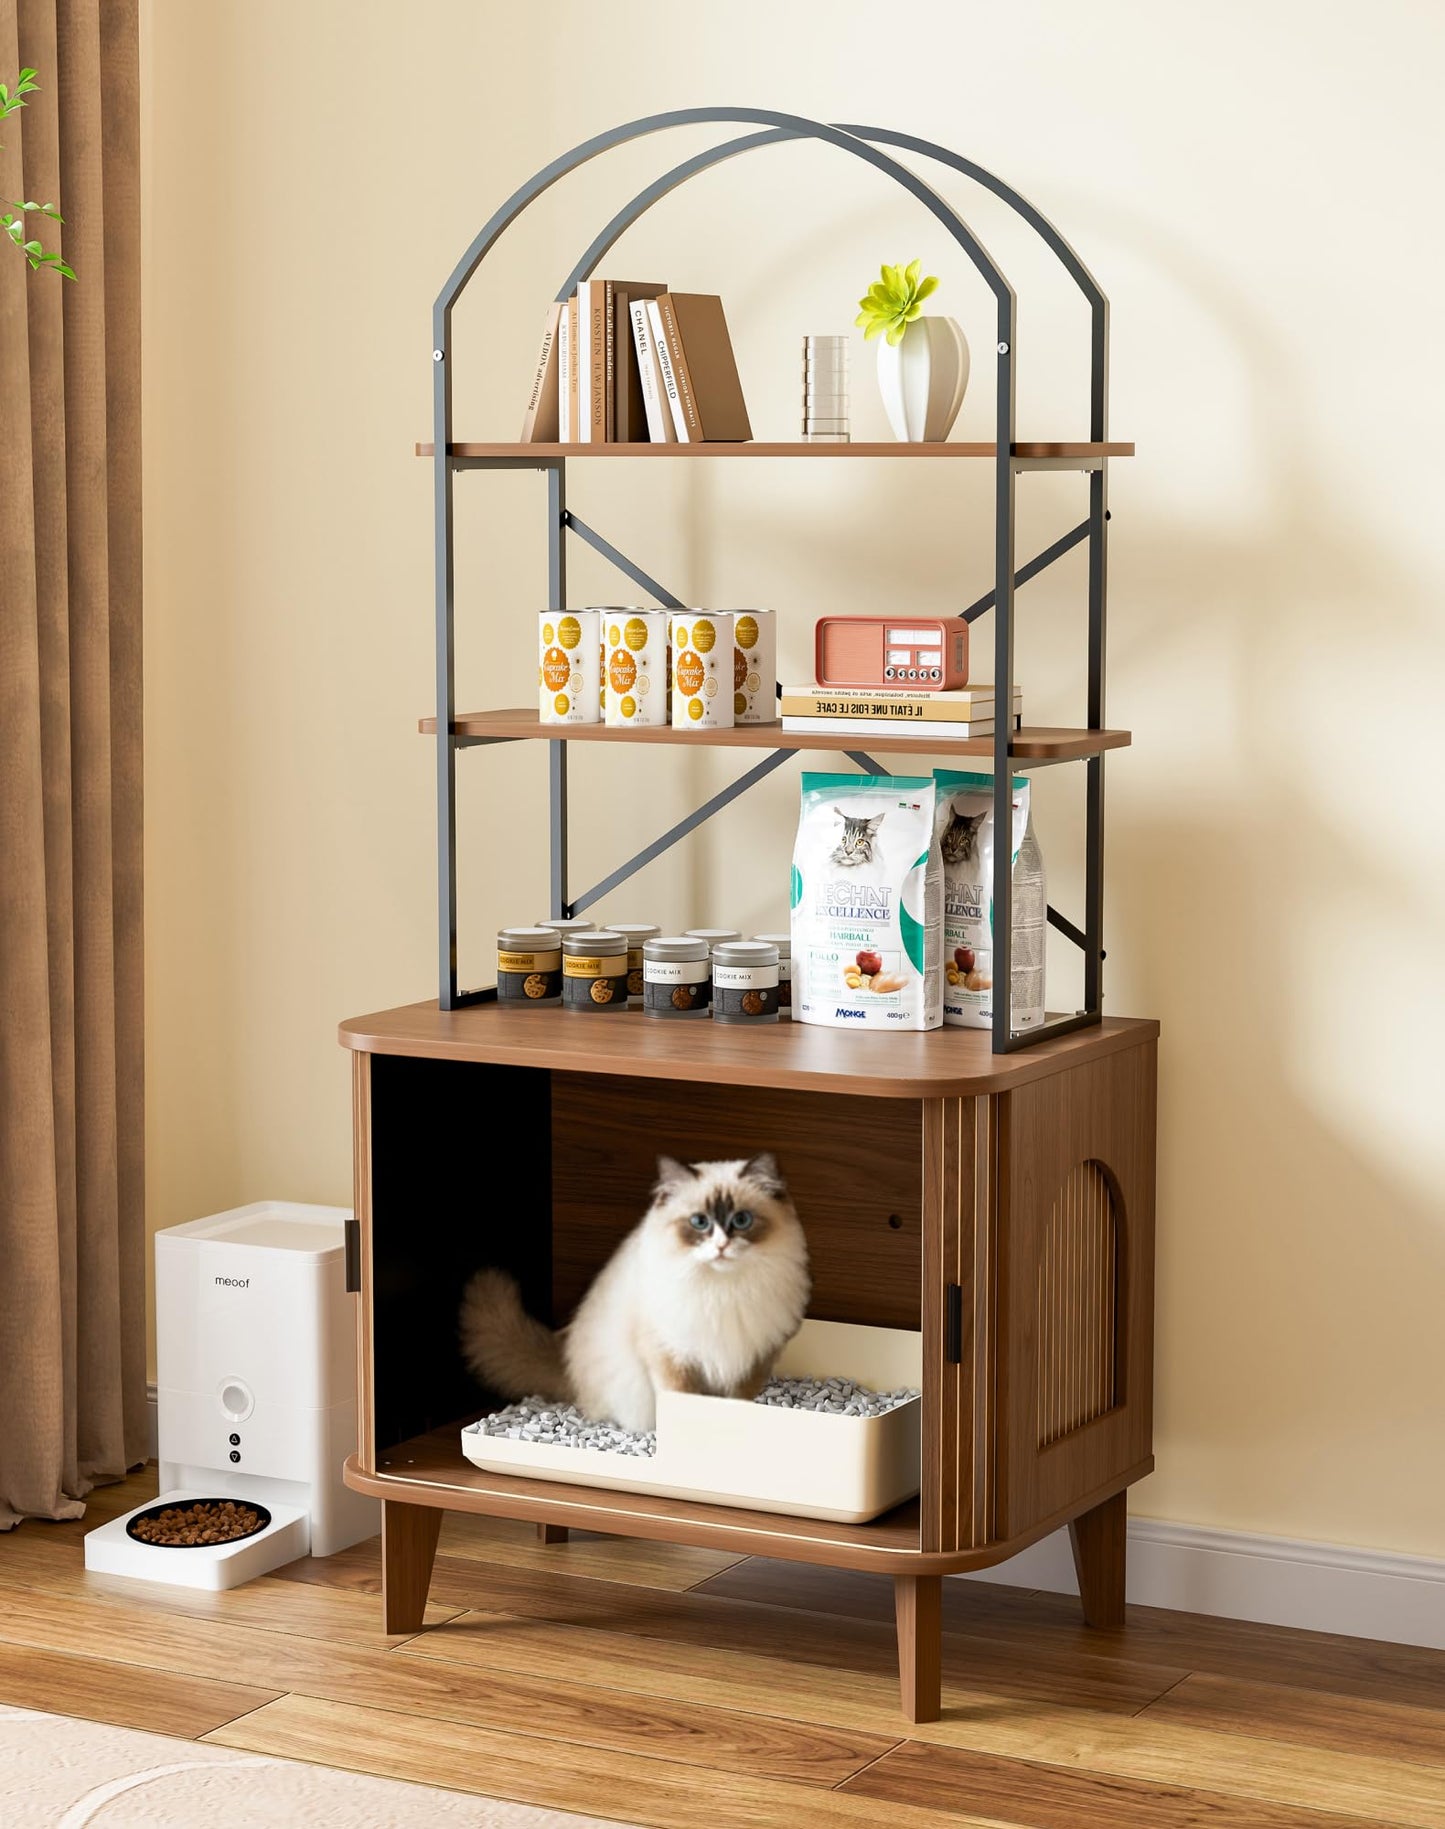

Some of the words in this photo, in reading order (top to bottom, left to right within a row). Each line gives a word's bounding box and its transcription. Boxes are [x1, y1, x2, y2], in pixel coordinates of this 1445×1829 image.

[635, 310, 648, 355] CHANEL
[540, 330, 552, 366] AVEDON
[658, 340, 676, 399] CHIPPERFIELD
[528, 368, 543, 411] advertising
[609, 662, 634, 675] Cupcake
[677, 664, 702, 676] Cupcake
[551, 673, 564, 683] Mix
[615, 673, 631, 685] Mix
[683, 675, 699, 688] Mix
[945, 903, 982, 918] LLENCE
[830, 931, 872, 941] HAIRBALL
[945, 928, 966, 939] RBALL
[835, 1008, 867, 1019] MONGE
[215, 1276, 250, 1288] meoof
